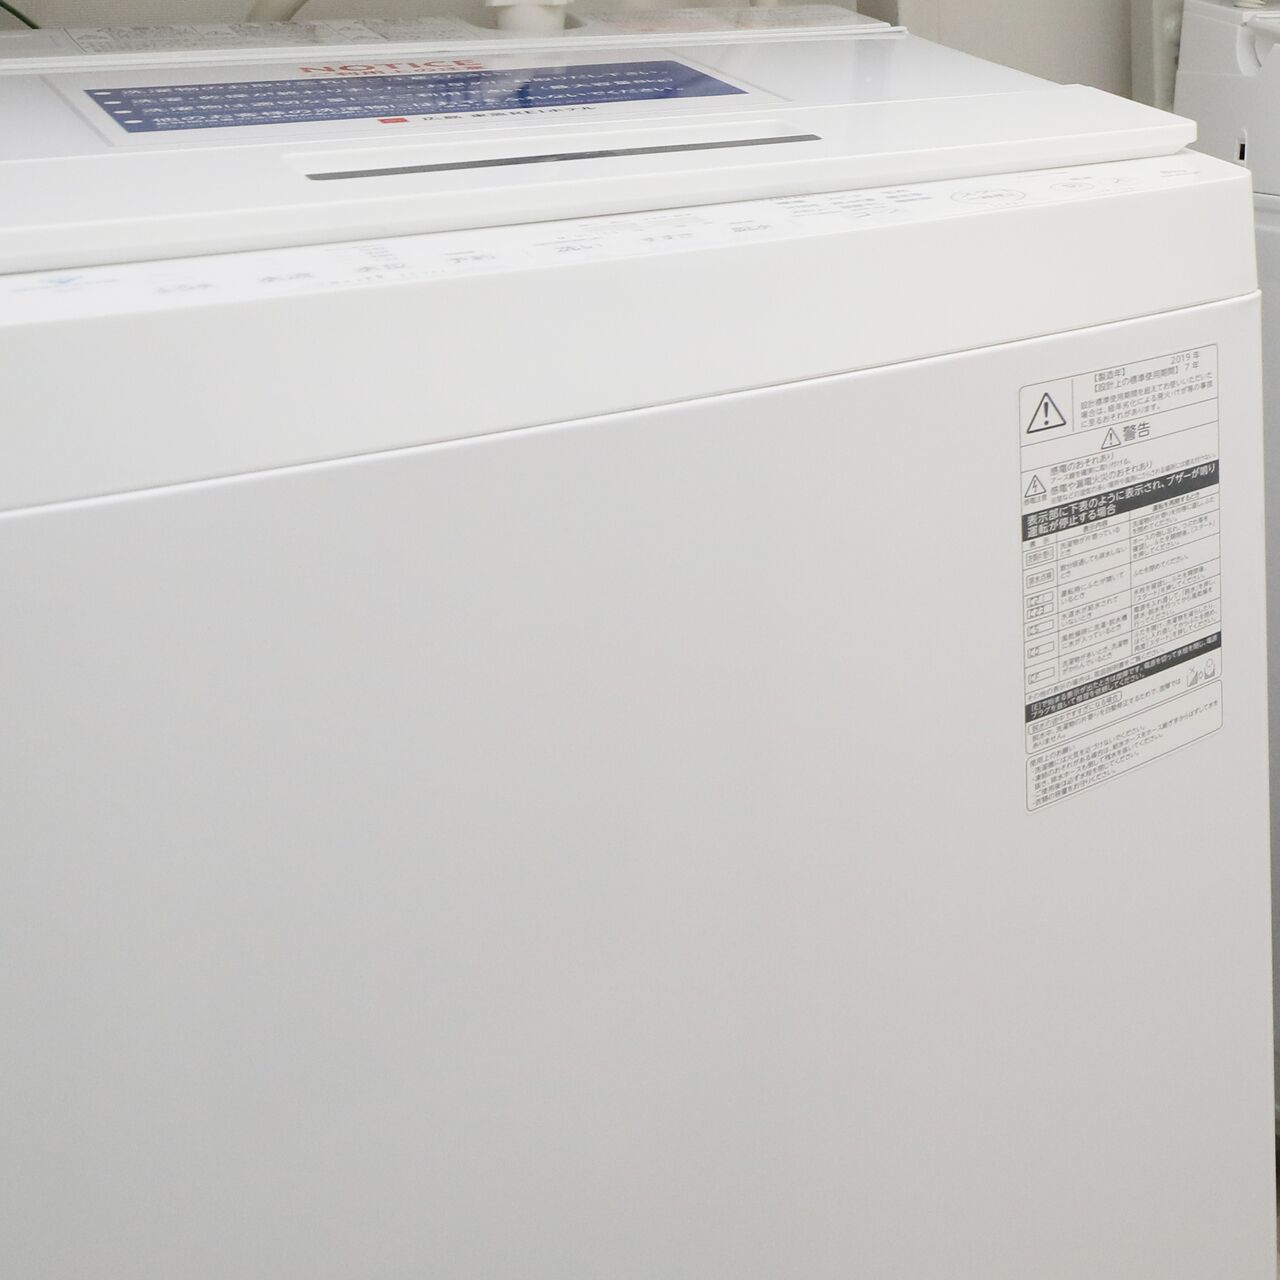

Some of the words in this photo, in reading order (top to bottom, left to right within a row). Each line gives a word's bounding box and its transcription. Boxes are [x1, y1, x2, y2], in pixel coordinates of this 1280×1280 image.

[299, 58, 484, 74] NOTICE
[1123, 422, 1151, 441] 警告
[1027, 506, 1117, 539] 運転が停止する場合
